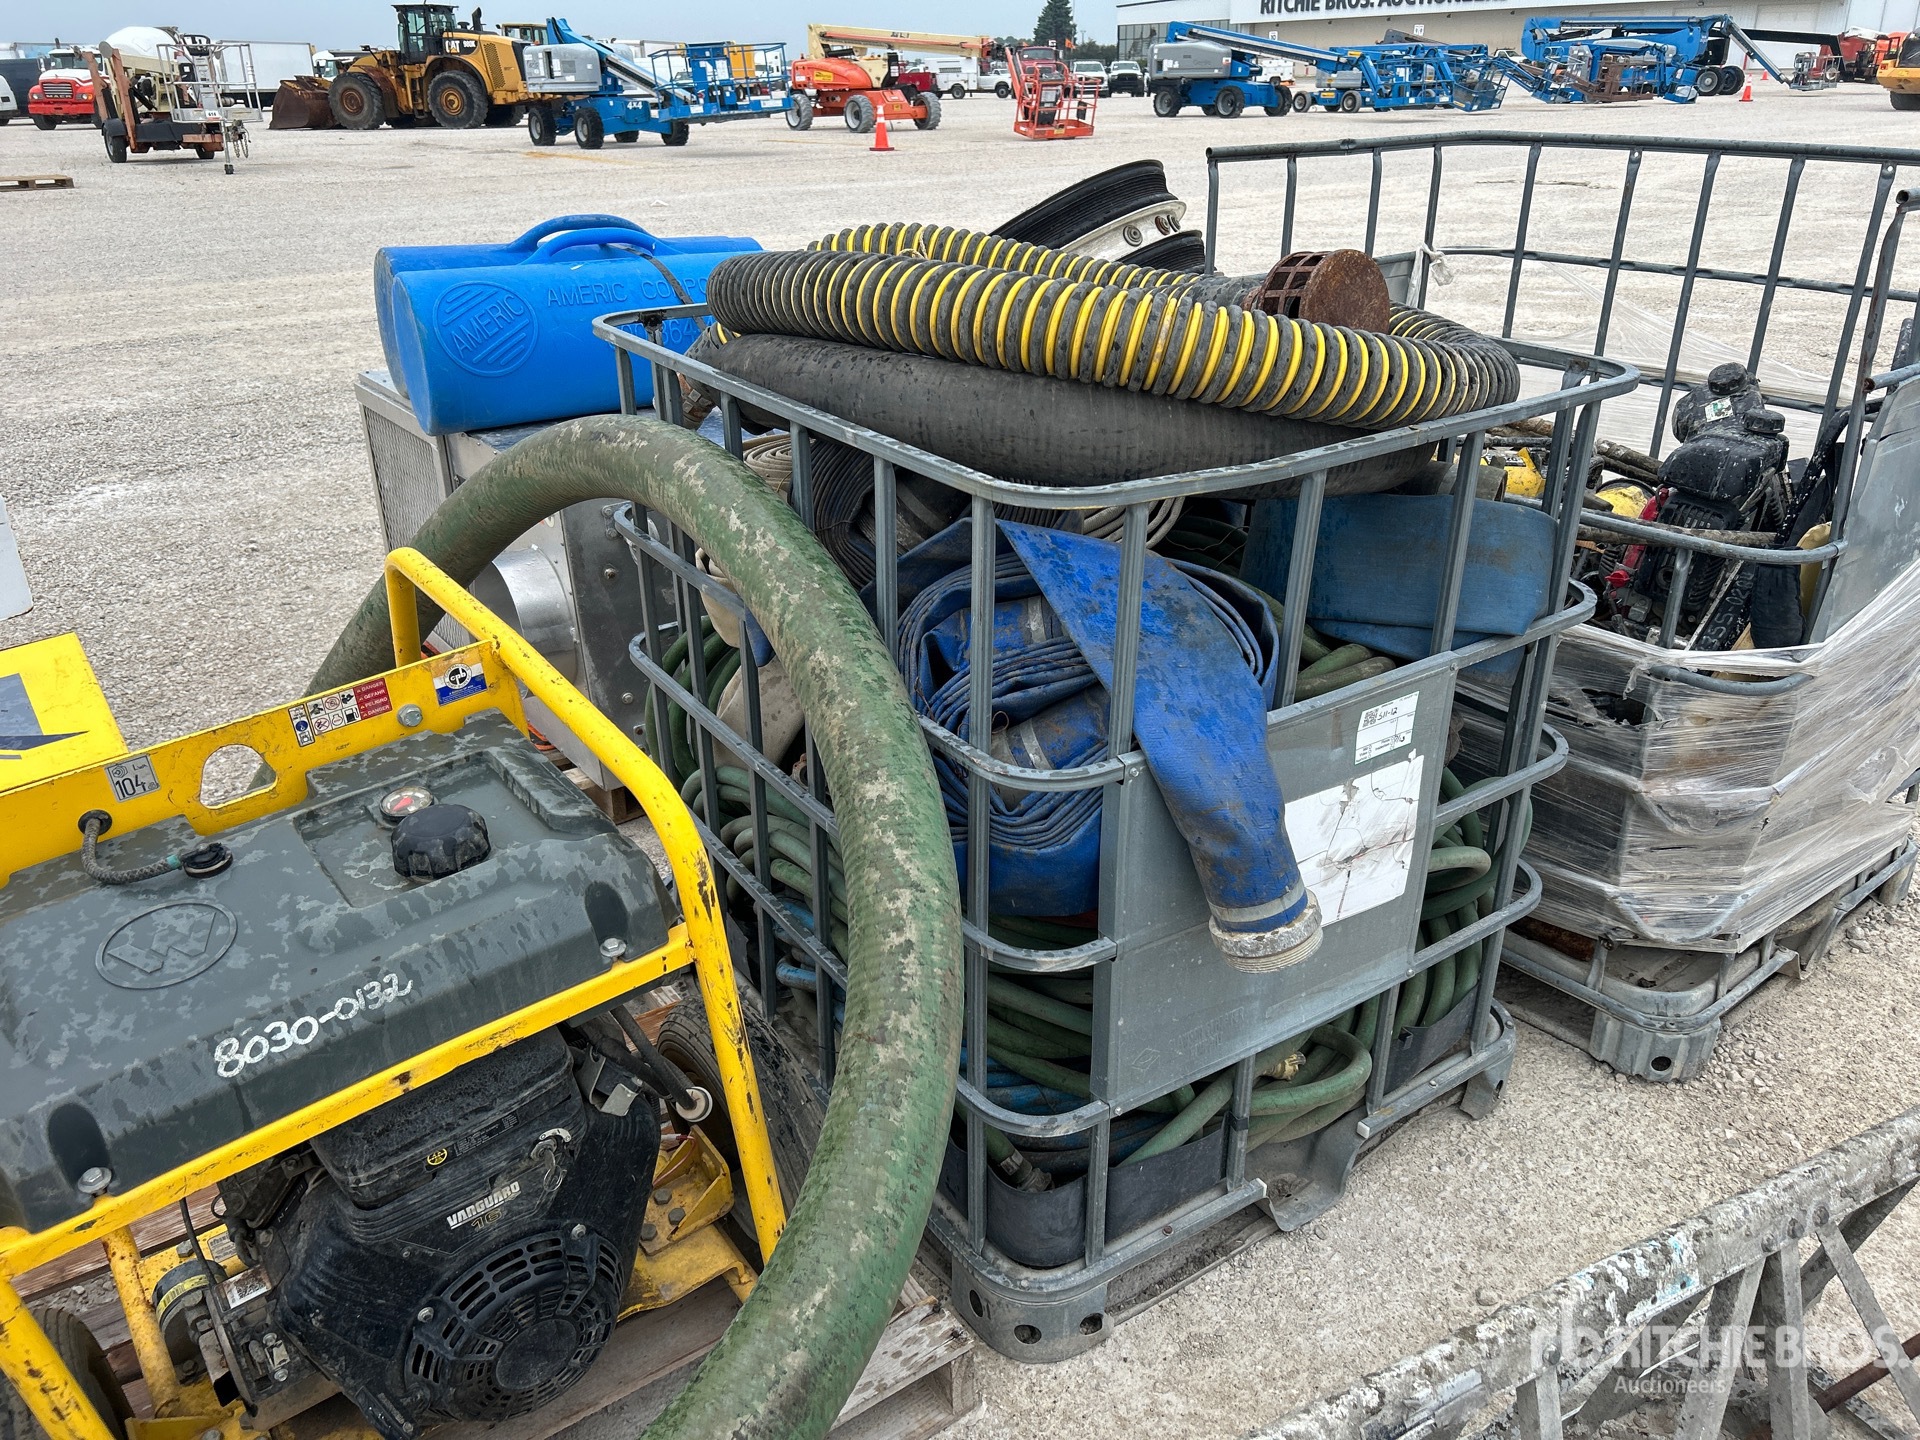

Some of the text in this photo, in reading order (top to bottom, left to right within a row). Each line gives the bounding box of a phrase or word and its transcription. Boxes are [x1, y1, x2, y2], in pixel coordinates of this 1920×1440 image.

[1260, 0, 1320, 14] RITCHIE
[445, 40, 460, 54] CAT
[547, 282, 628, 307] AMERIC
[451, 294, 525, 359] AMERIC
[450, 667, 468, 686] cpb
[361, 681, 384, 692] DANGER
[363, 689, 386, 700] GEFAHR
[365, 697, 388, 708] PELIGRO
[368, 704, 391, 716] DANGER
[115, 774, 147, 798] 104
[214, 973, 414, 1078] 8030-0132
[446, 1181, 520, 1227] VANGUARD
[471, 1209, 502, 1231] 16
